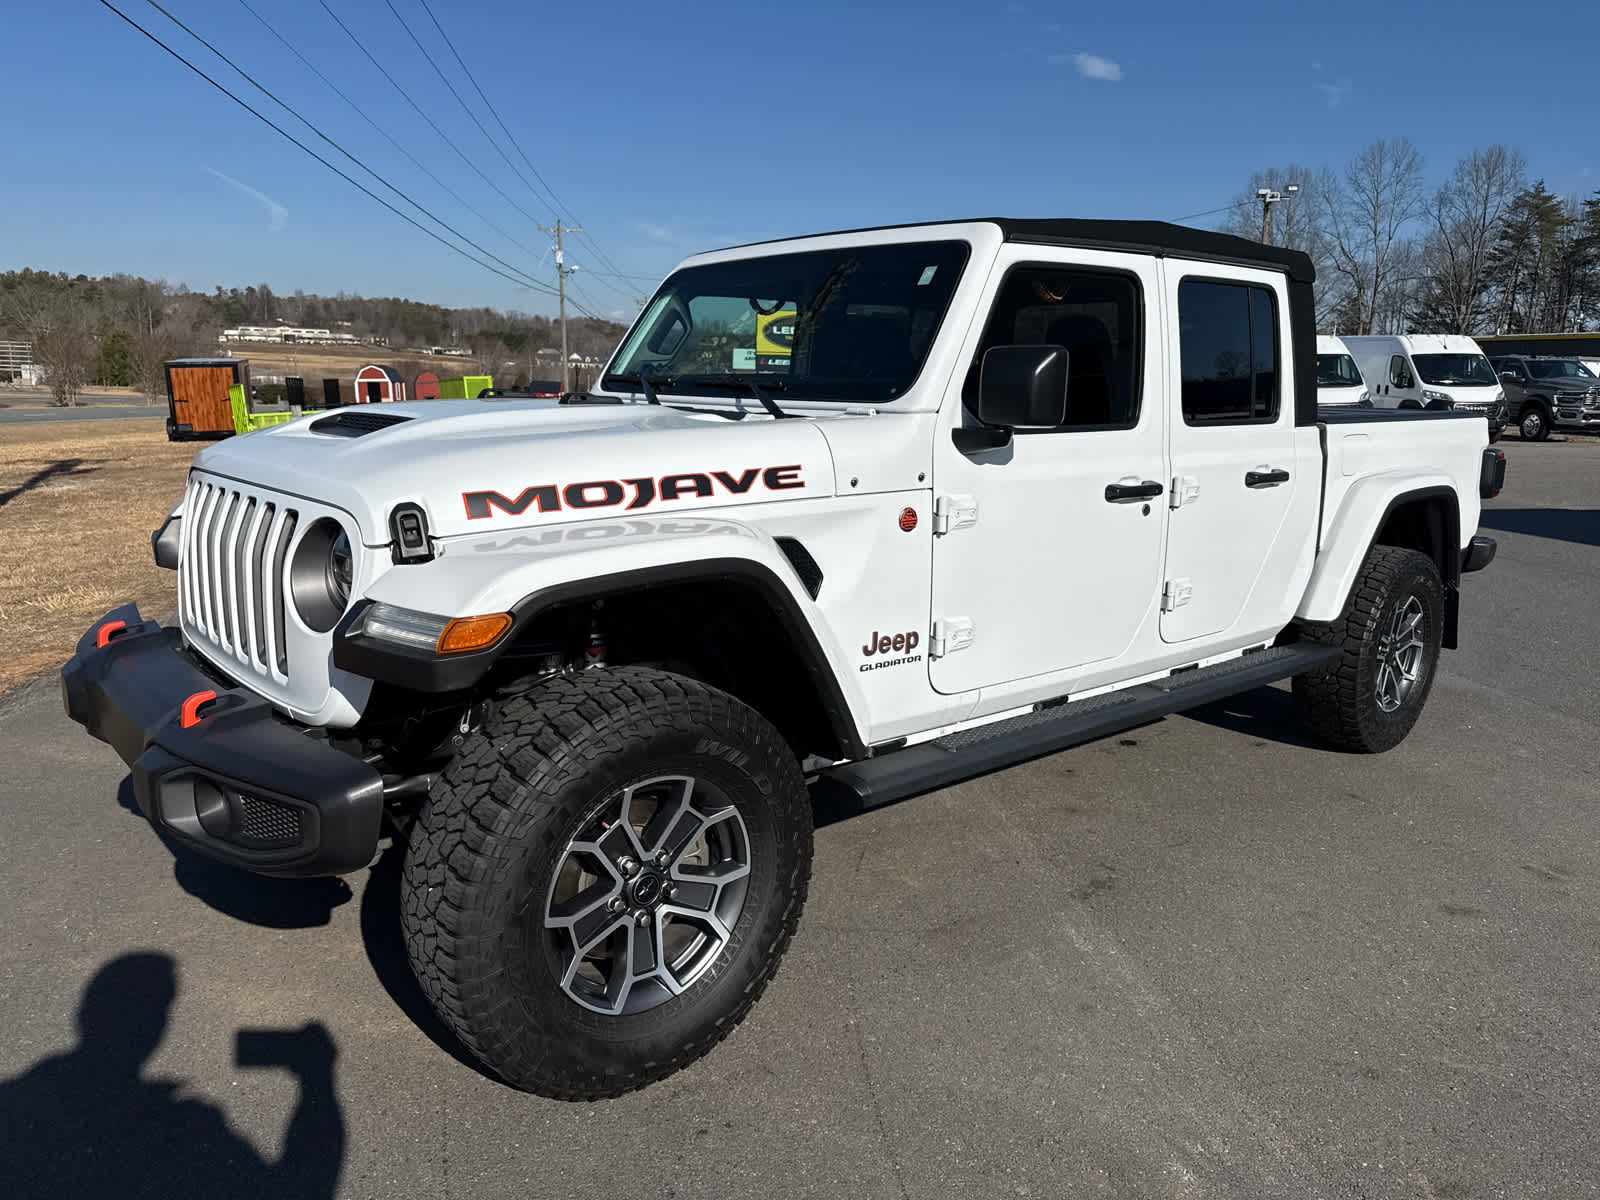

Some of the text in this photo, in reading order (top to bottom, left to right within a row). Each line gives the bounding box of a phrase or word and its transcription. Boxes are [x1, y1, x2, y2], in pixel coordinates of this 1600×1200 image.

[462, 464, 805, 520] MOJAVE
[862, 631, 919, 656] Jeep
[859, 655, 921, 671] GLADIATOR
